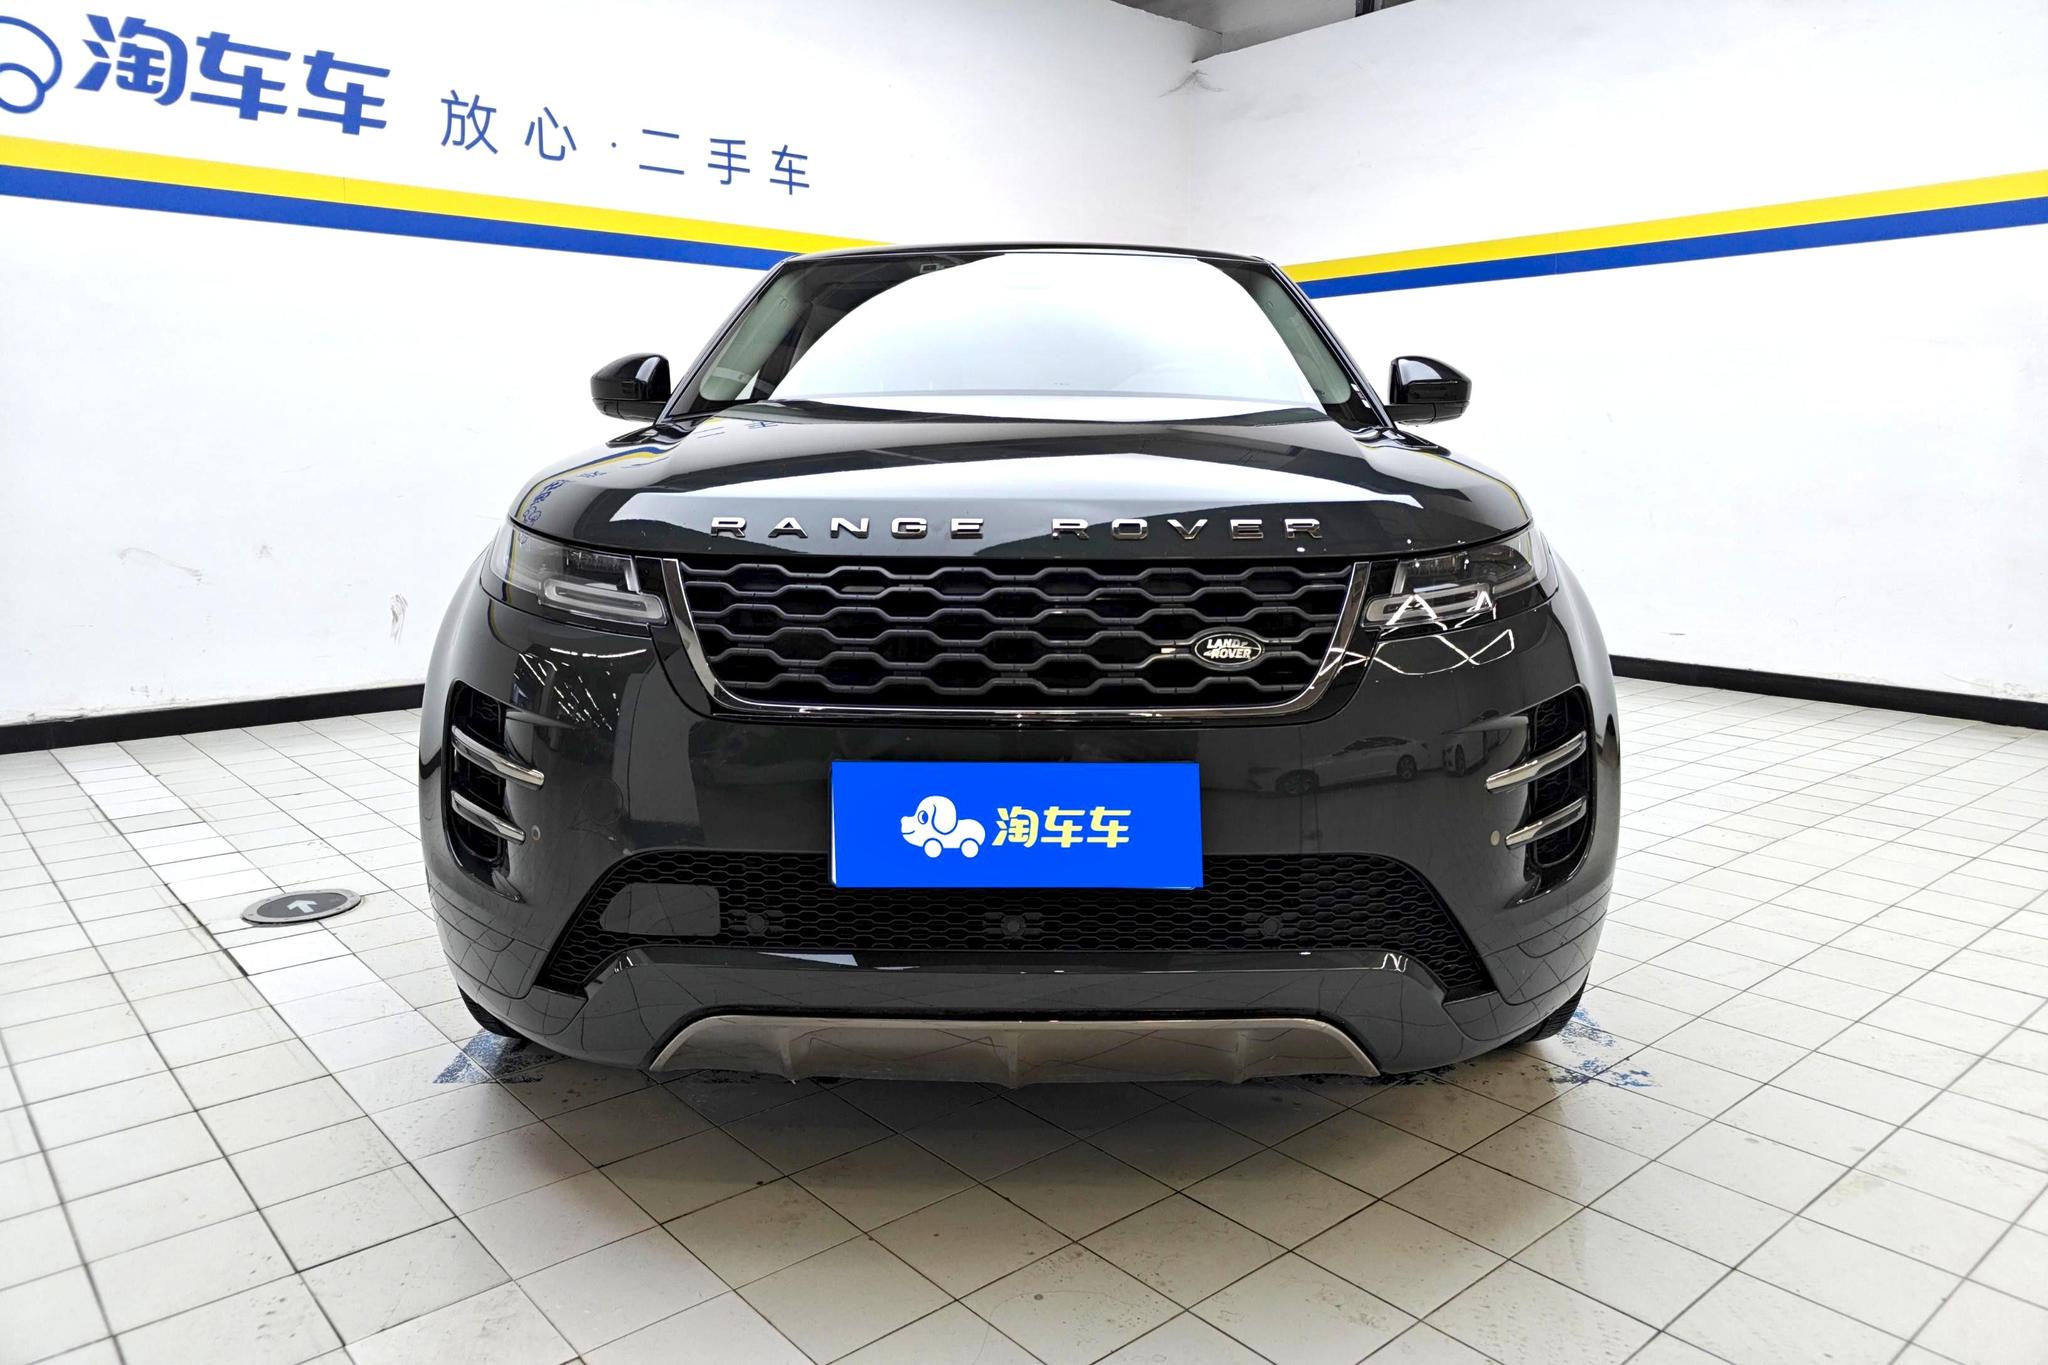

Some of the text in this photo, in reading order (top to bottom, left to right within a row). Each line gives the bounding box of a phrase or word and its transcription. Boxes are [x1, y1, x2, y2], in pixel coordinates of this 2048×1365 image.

[76, 14, 391, 135] 淘车车
[711, 516, 1323, 540] RANGE ROVER
[1206, 638, 1241, 649] LAND
[1210, 648, 1252, 659] ROVER
